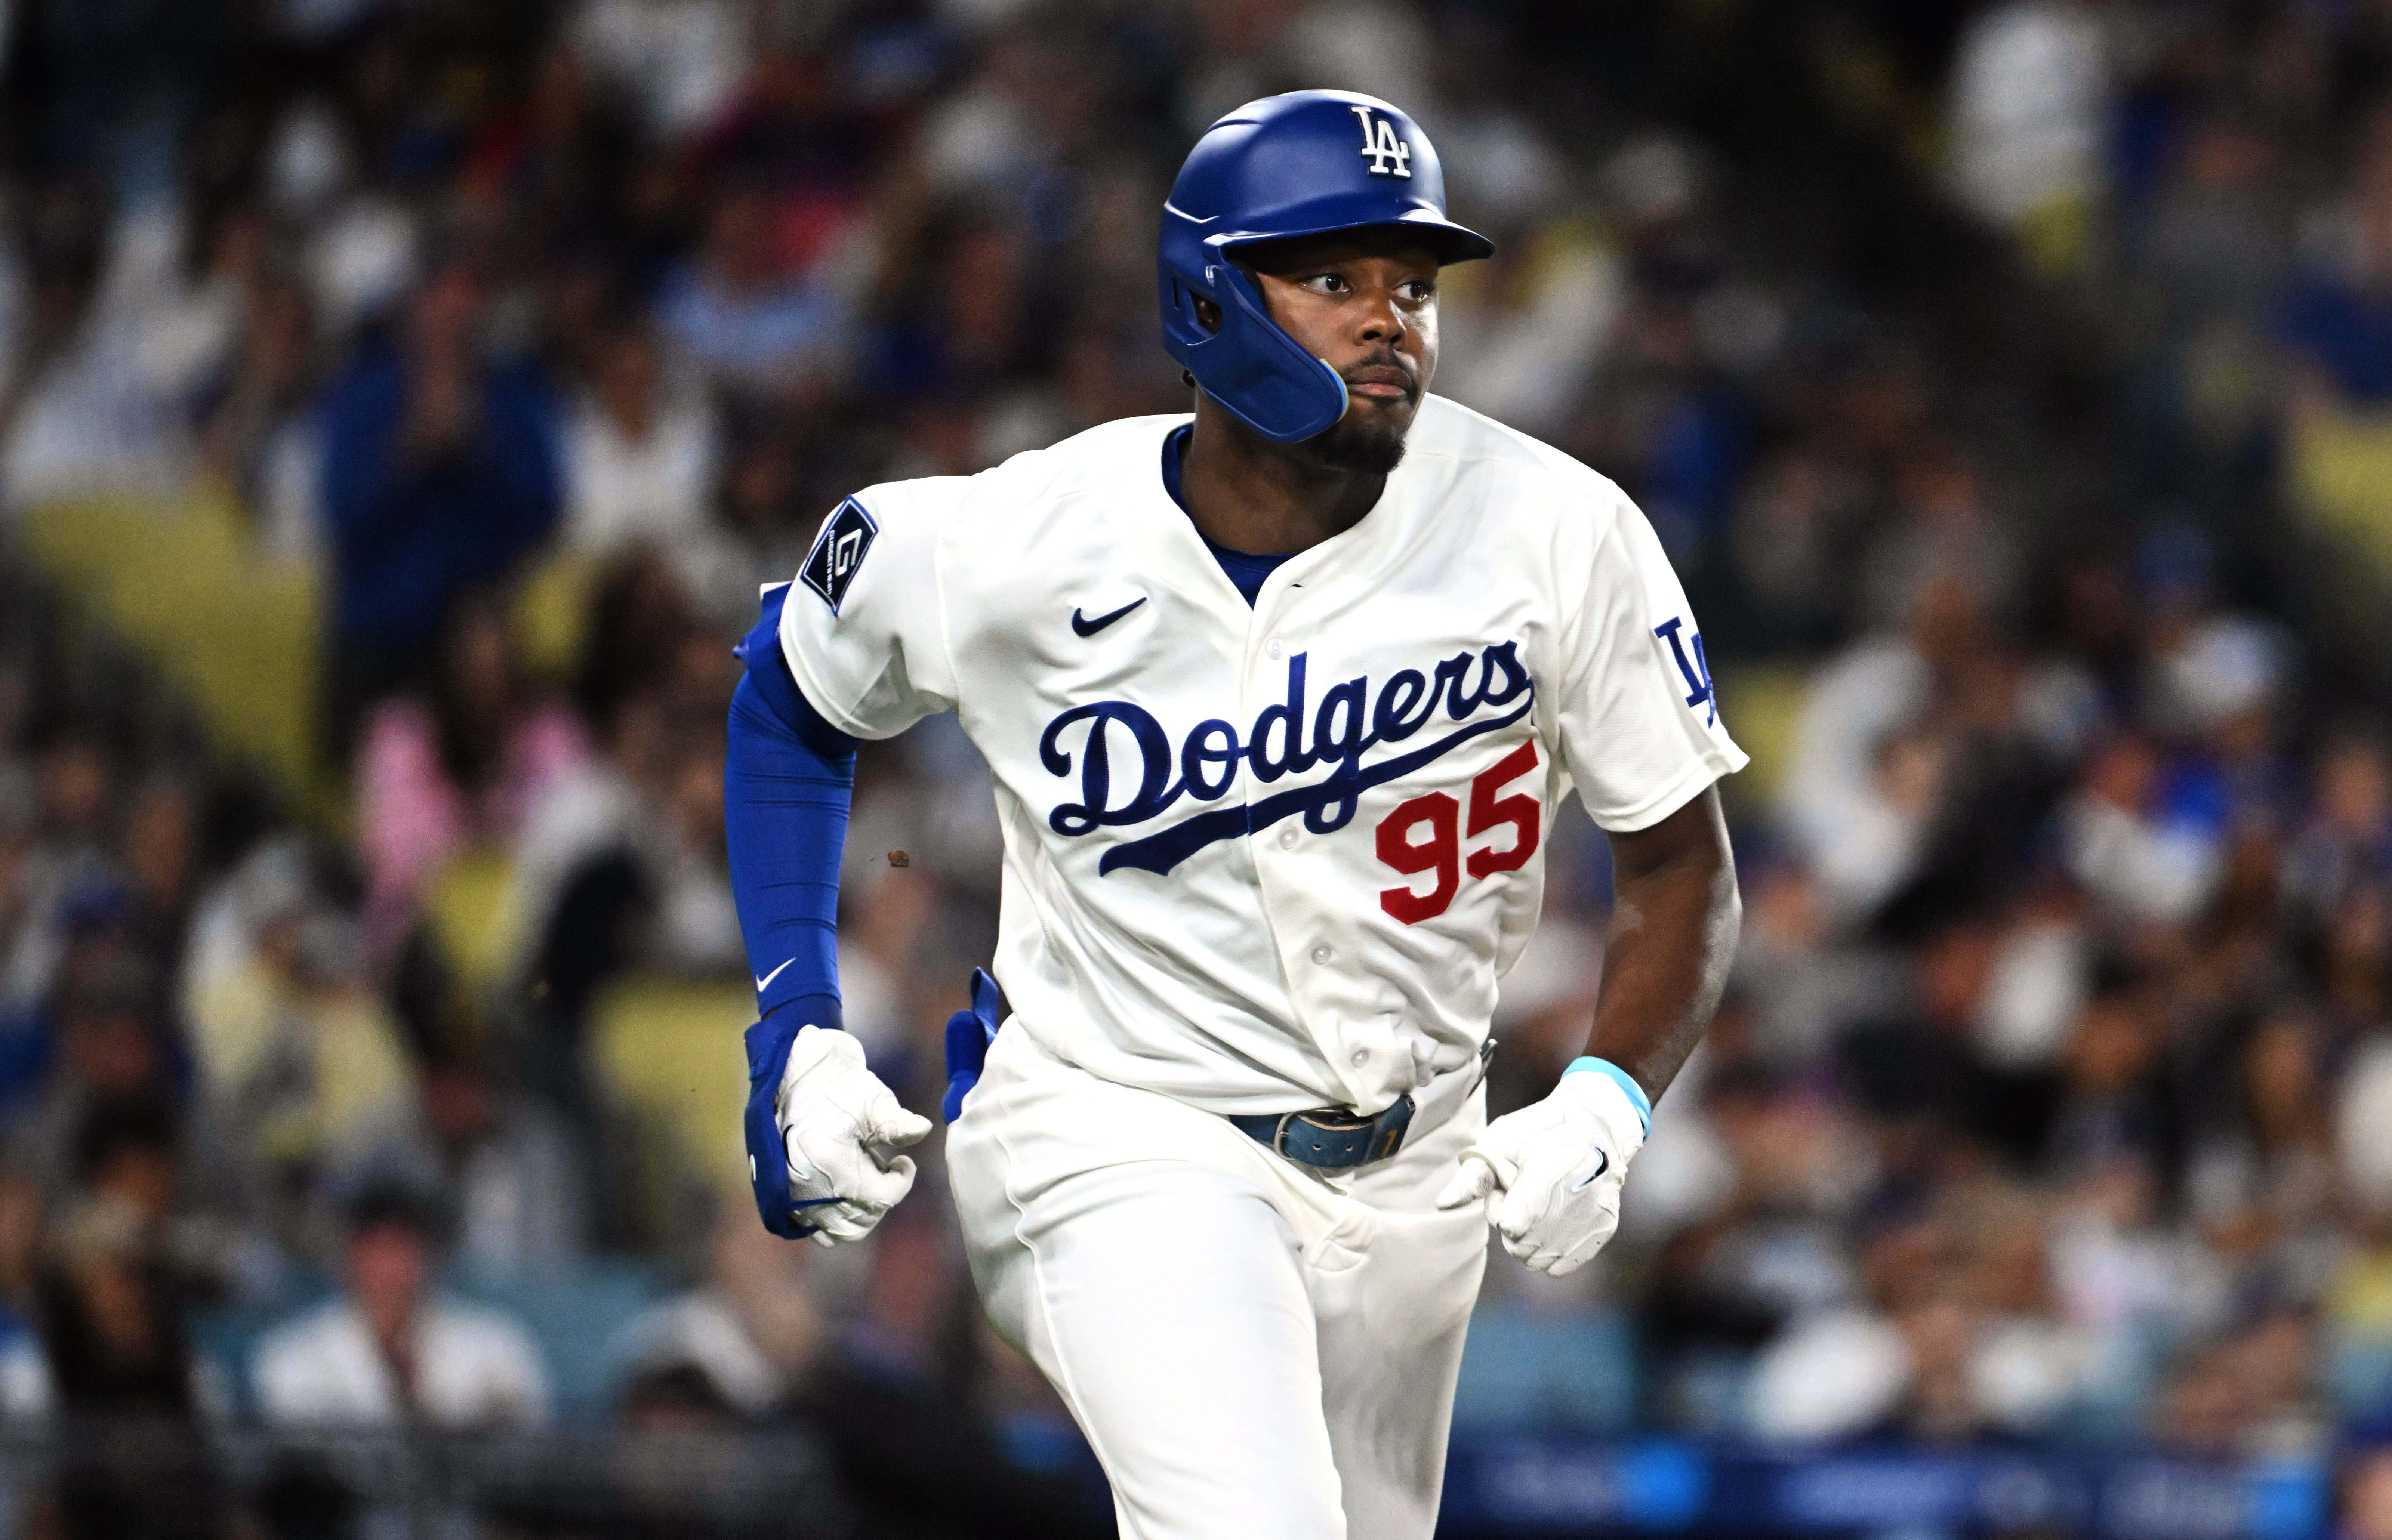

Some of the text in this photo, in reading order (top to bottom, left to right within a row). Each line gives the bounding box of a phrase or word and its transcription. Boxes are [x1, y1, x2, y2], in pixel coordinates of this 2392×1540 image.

[1350, 105, 1411, 179] LA
[1039, 639, 1535, 877] Dodgers
[1375, 737, 1540, 925] 95
